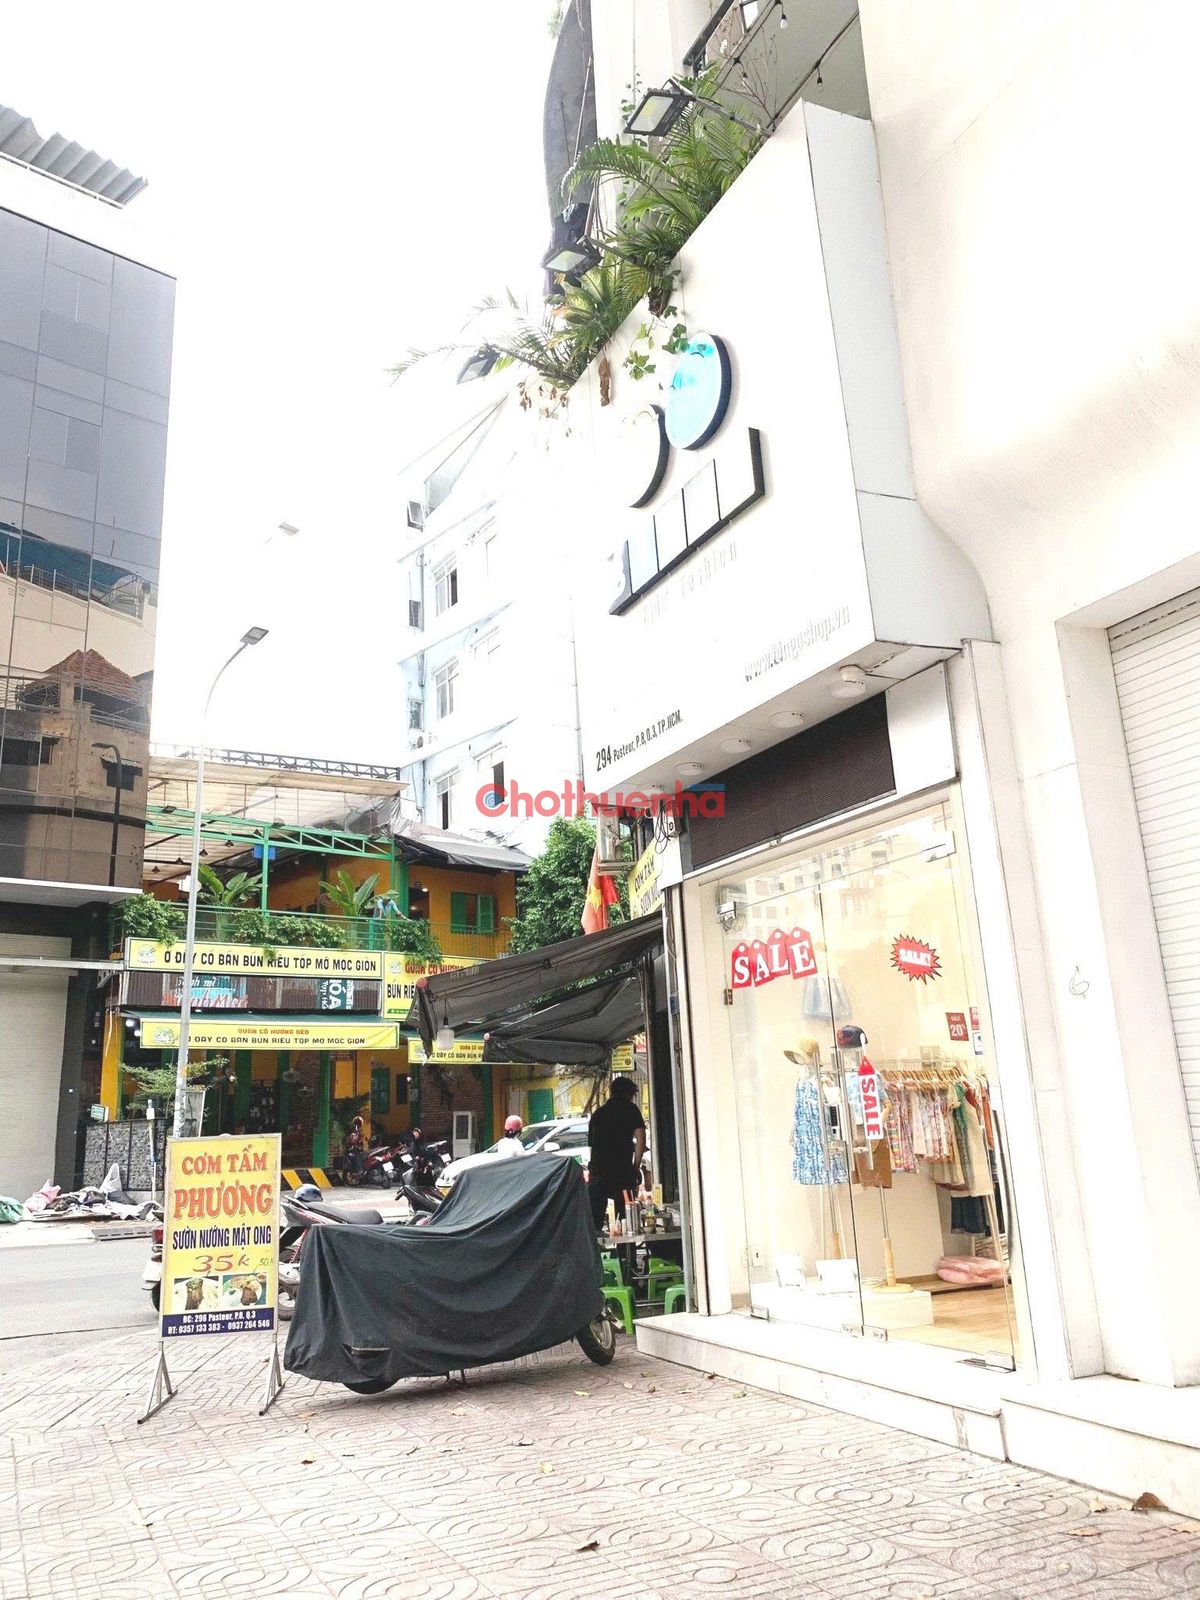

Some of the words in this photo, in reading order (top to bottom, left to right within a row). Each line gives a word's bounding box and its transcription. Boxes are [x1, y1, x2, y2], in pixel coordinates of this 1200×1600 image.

[596, 745, 612, 772] 294
[613, 741, 636, 762] Pasteur,
[201, 949, 214, 965] CÓ
[243, 951, 264, 967] BÚN
[733, 940, 817, 984] SALE
[387, 979, 402, 998] BÚN
[862, 1077, 880, 1136] SALE
[181, 1152, 222, 1175] CƠM
[227, 1144, 268, 1173] TẤM
[173, 1180, 273, 1219] PHƯƠNG
[172, 1226, 197, 1250] SƯỜN
[200, 1225, 230, 1249] NƯỚNG
[232, 1222, 251, 1250] MẬT
[253, 1225, 272, 1244] ONG
